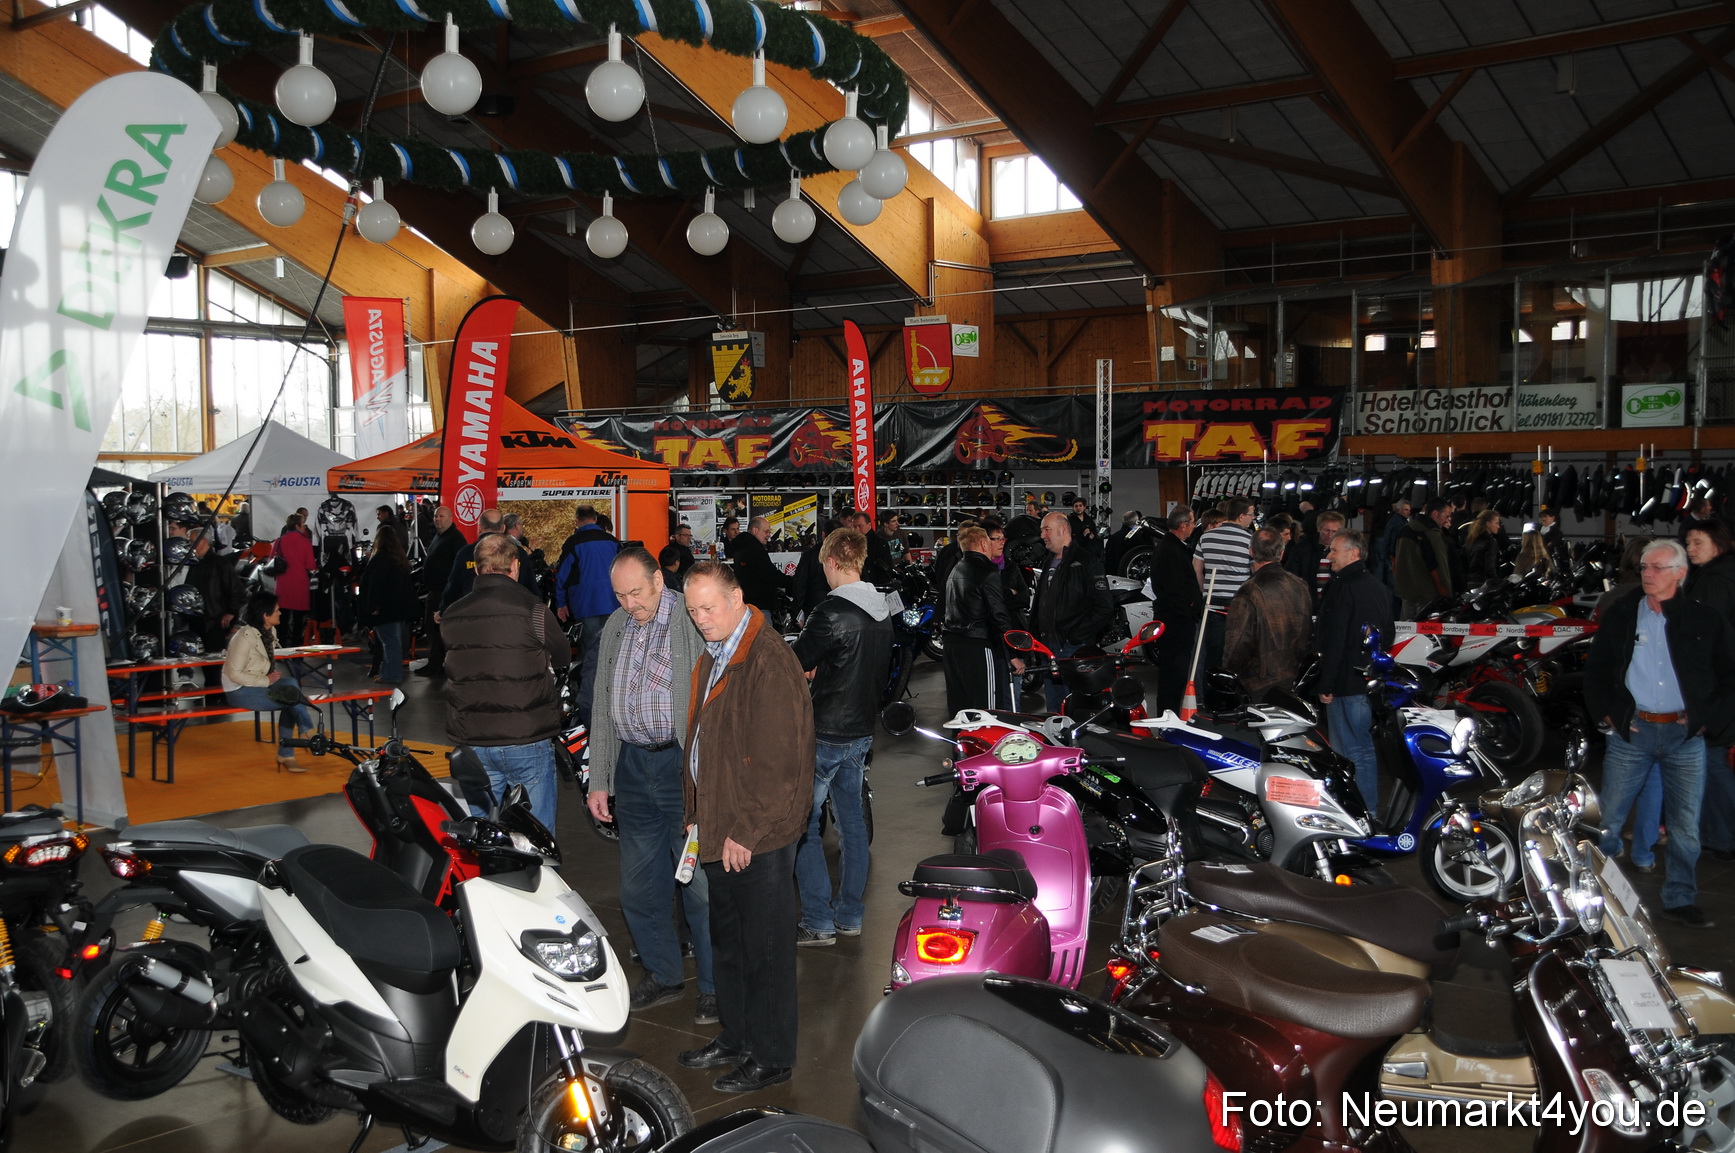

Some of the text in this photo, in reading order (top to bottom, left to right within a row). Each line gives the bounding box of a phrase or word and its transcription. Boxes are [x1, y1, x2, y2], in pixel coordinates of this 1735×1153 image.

[56, 123, 188, 331] DEKRA
[1143, 396, 1332, 413] MOTORRAD
[1360, 386, 1513, 412] Hotel-Gasthof
[1518, 393, 1577, 409] Höhenberg
[458, 341, 498, 484] YAMAHA
[1517, 411, 1597, 428] el.09181/32712
[653, 416, 772, 431] MOTORRAD
[1363, 410, 1505, 434] Schönblick
[500, 430, 577, 449] KTM
[1143, 417, 1332, 462] TAF
[653, 434, 773, 470] TAF
[280, 476, 321, 487] AGUSTA
[593, 470, 629, 488] KTM
[541, 489, 575, 497] SUPER
